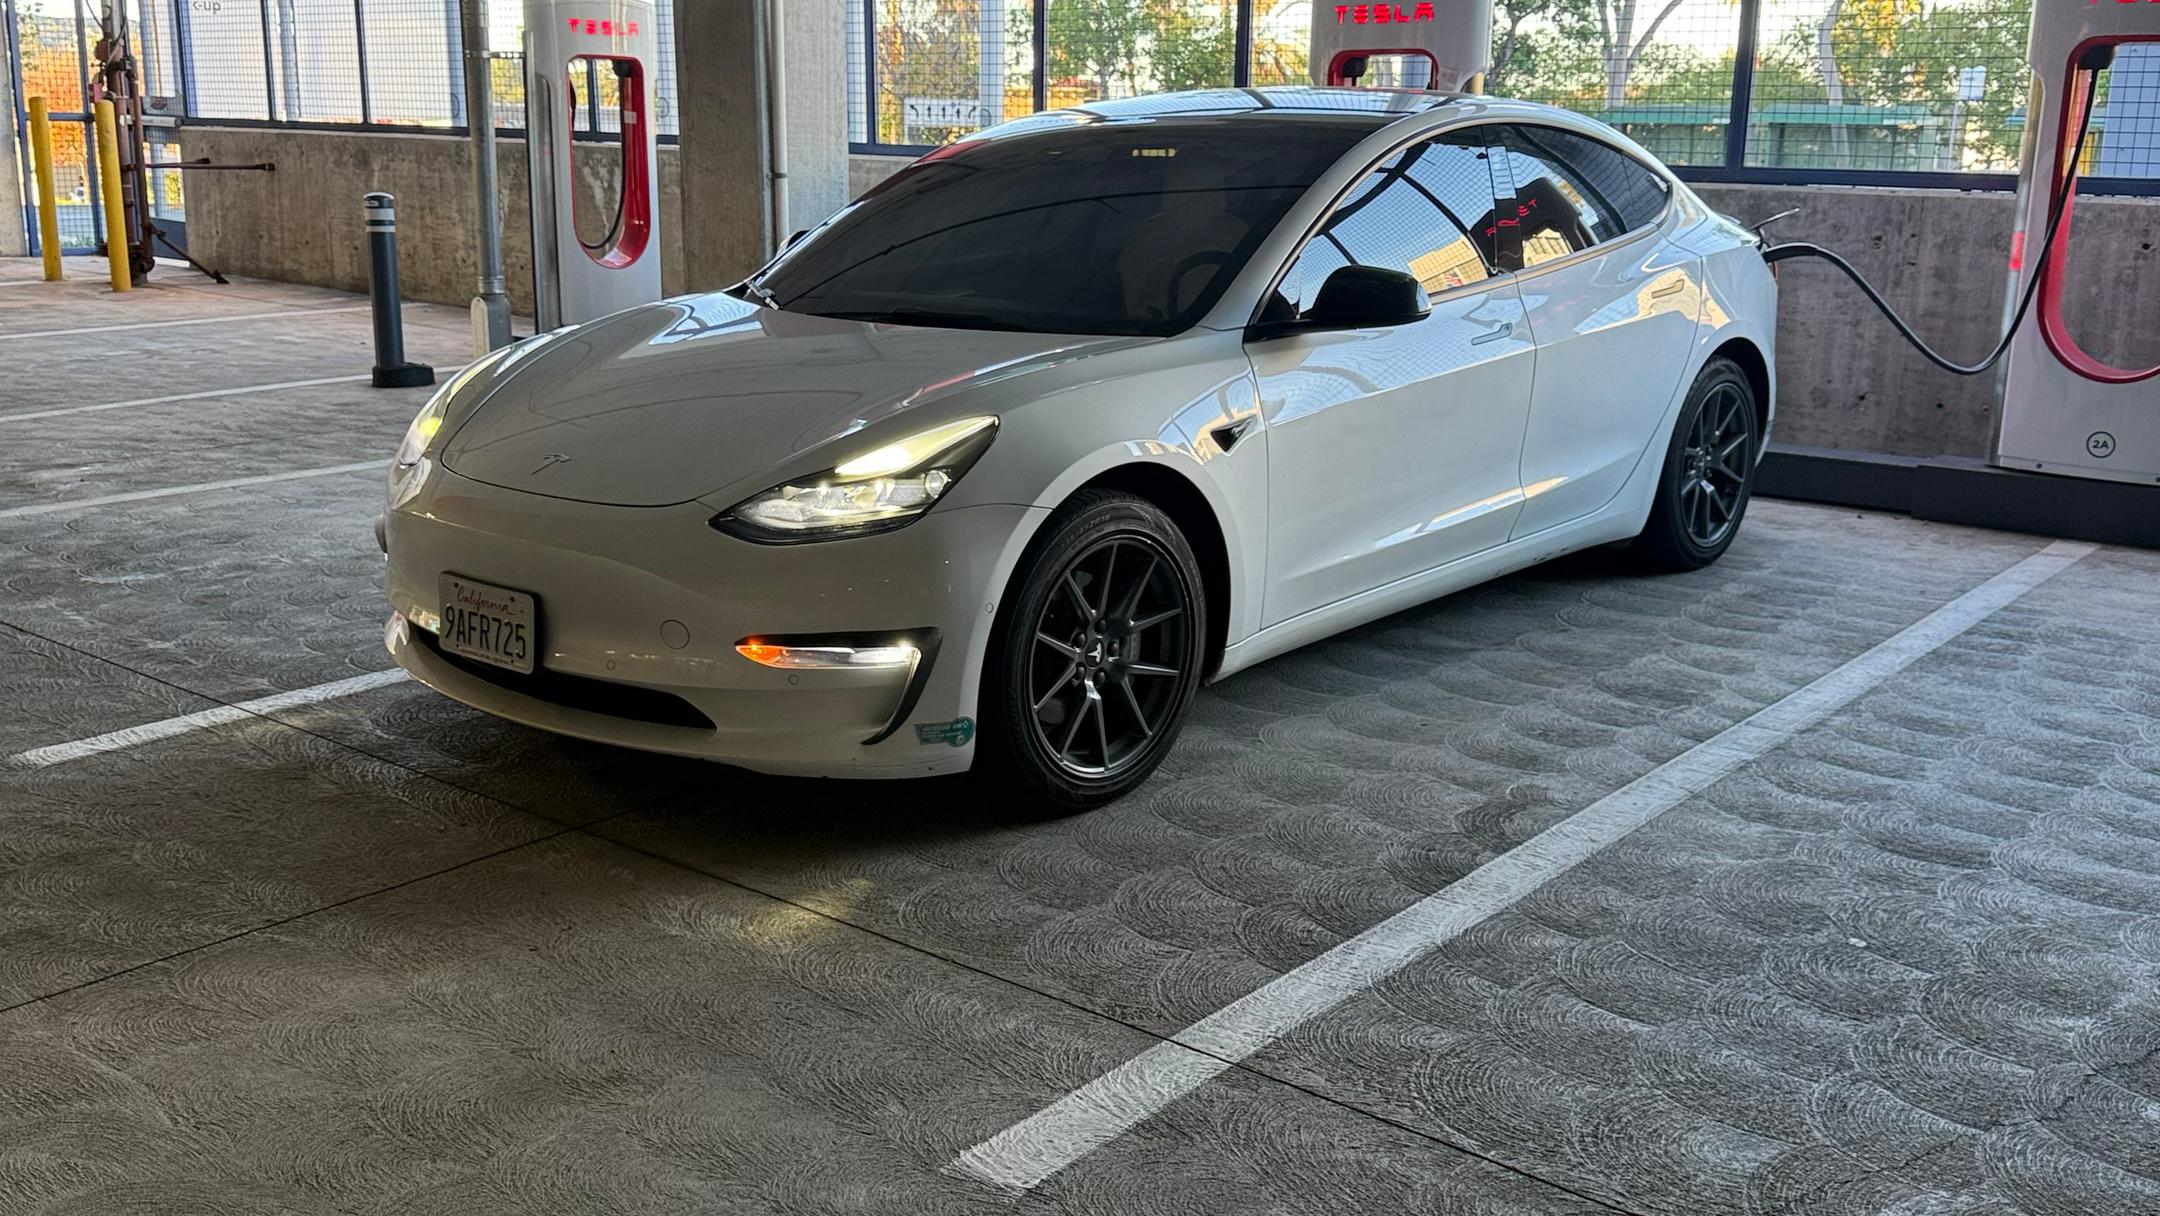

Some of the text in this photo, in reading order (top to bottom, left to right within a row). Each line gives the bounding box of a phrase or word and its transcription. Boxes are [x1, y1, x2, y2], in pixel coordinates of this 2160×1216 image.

[1334, 3, 1434, 24] TESLA
[567, 18, 639, 36] TESLA
[2092, 439, 2110, 449] 2A
[457, 586, 515, 615] California
[445, 605, 526, 659] 9AFR725
